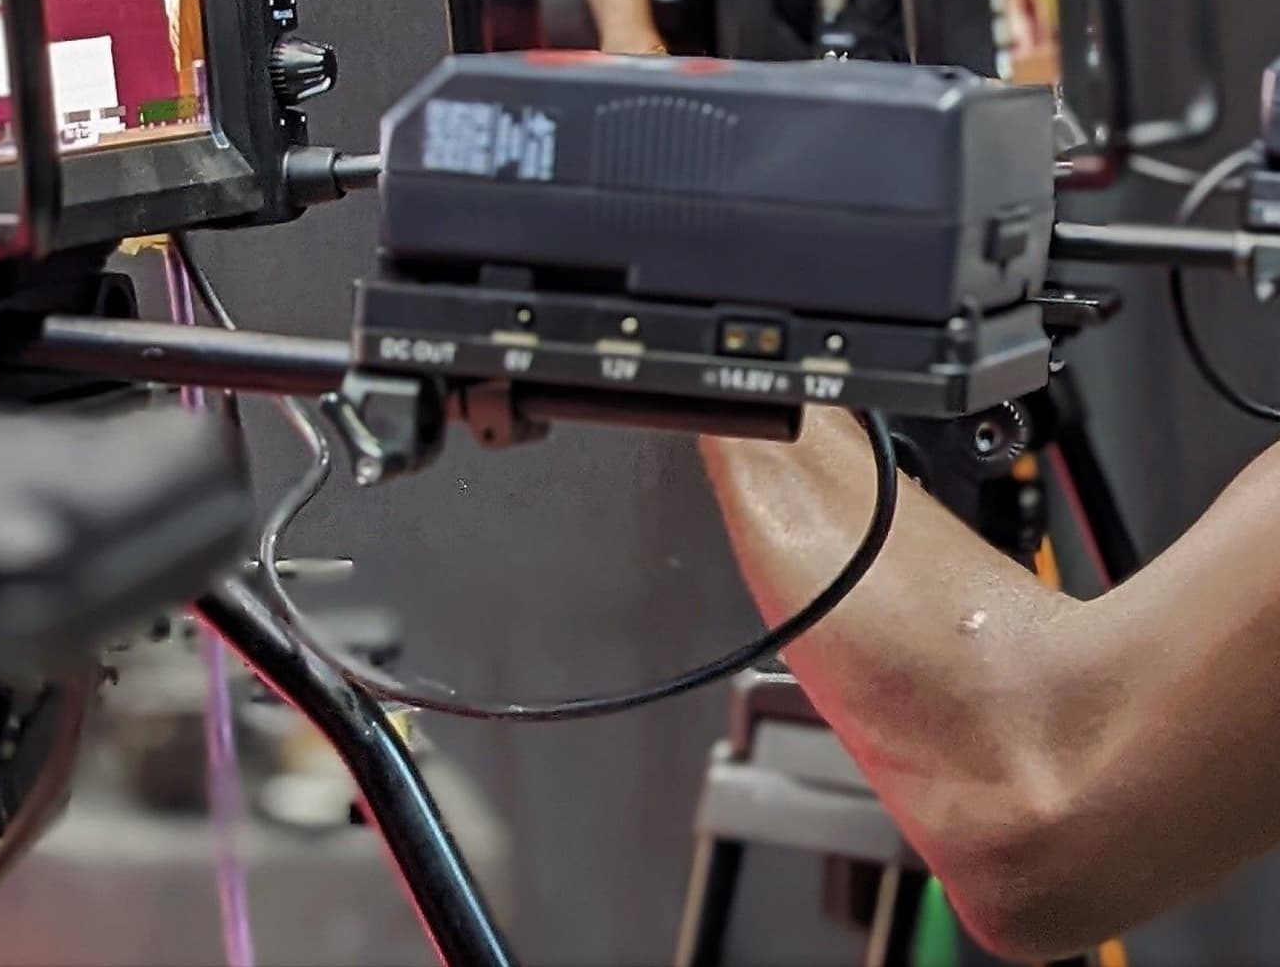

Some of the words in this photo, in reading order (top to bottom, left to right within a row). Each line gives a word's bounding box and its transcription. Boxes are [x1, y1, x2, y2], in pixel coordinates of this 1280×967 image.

[379, 336, 412, 361] DC
[412, 338, 456, 365] OUT
[602, 357, 639, 380] 12V
[804, 374, 844, 399] 12V
